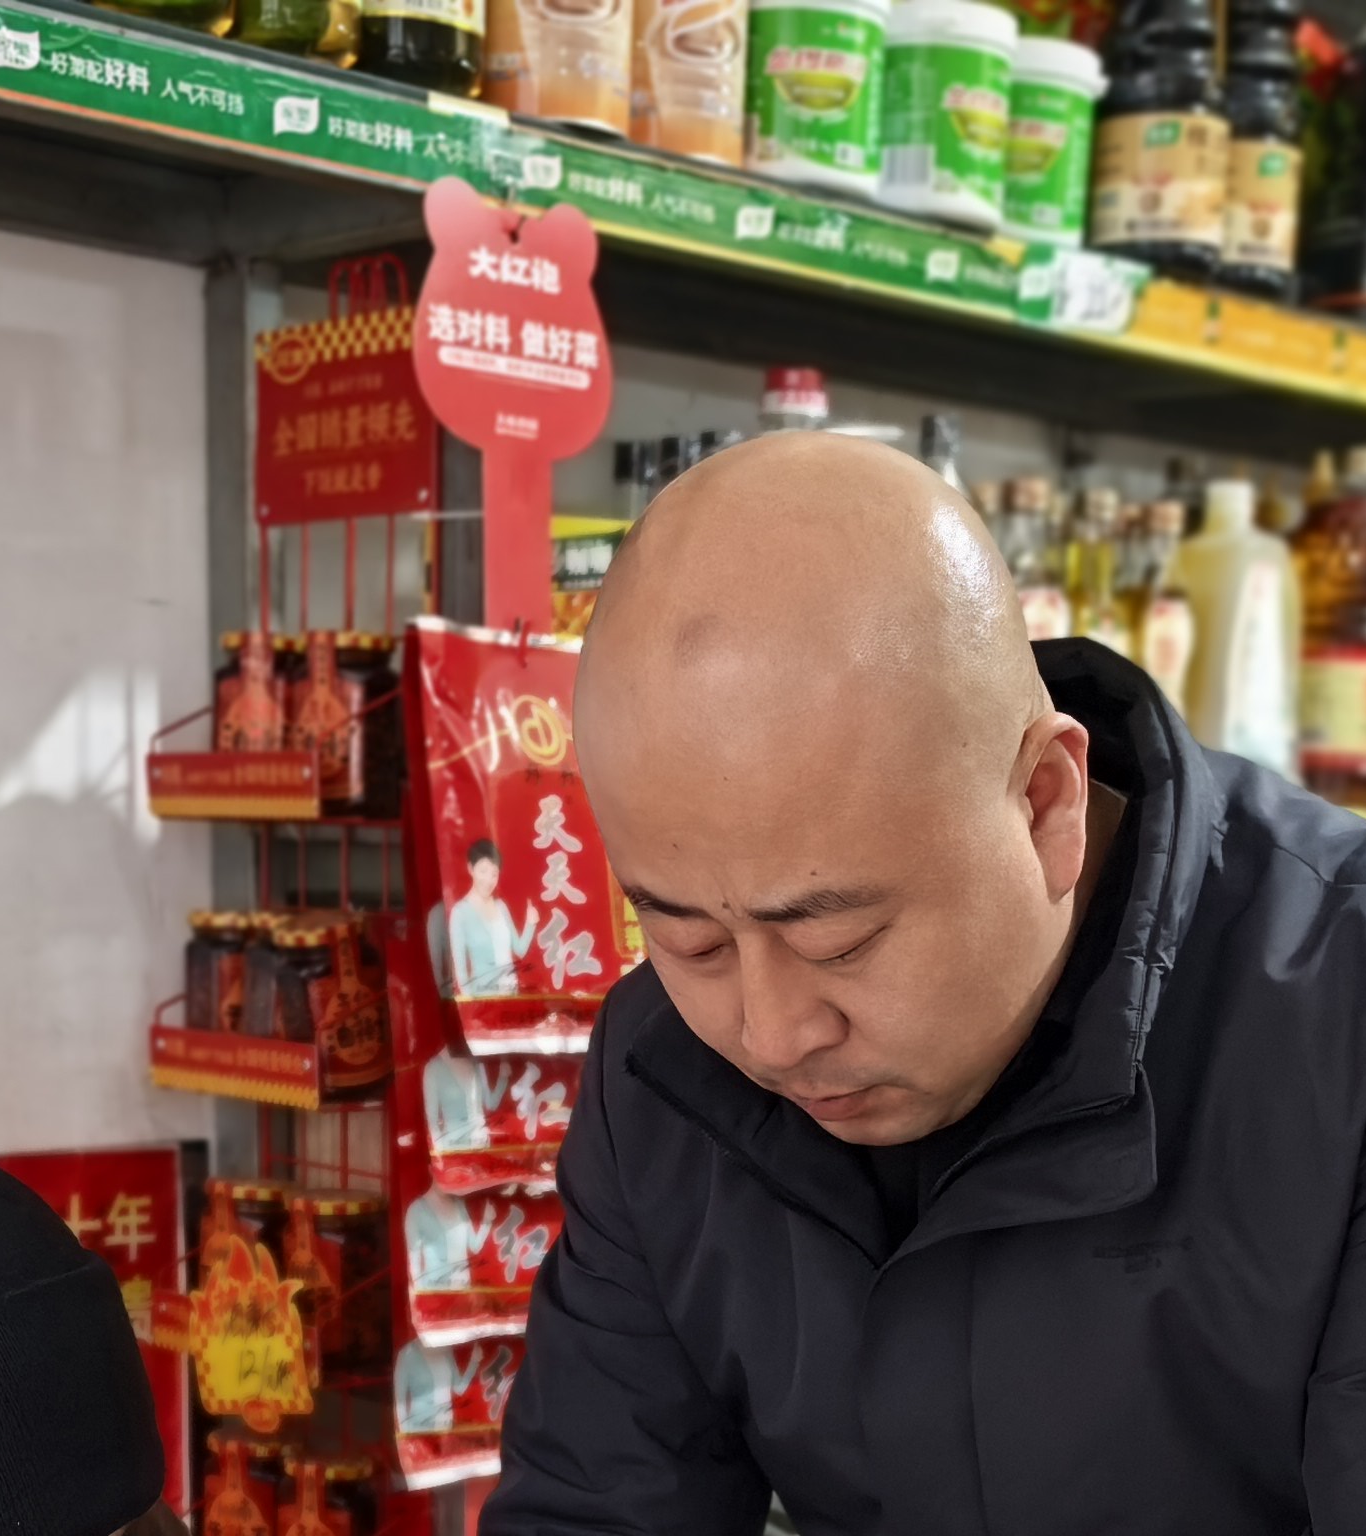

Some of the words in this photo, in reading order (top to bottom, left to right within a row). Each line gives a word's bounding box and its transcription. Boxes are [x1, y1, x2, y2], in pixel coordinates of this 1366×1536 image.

[468, 246, 563, 295] 大红袍
[427, 302, 512, 354] 选对料
[521, 321, 600, 369] 做好菜
